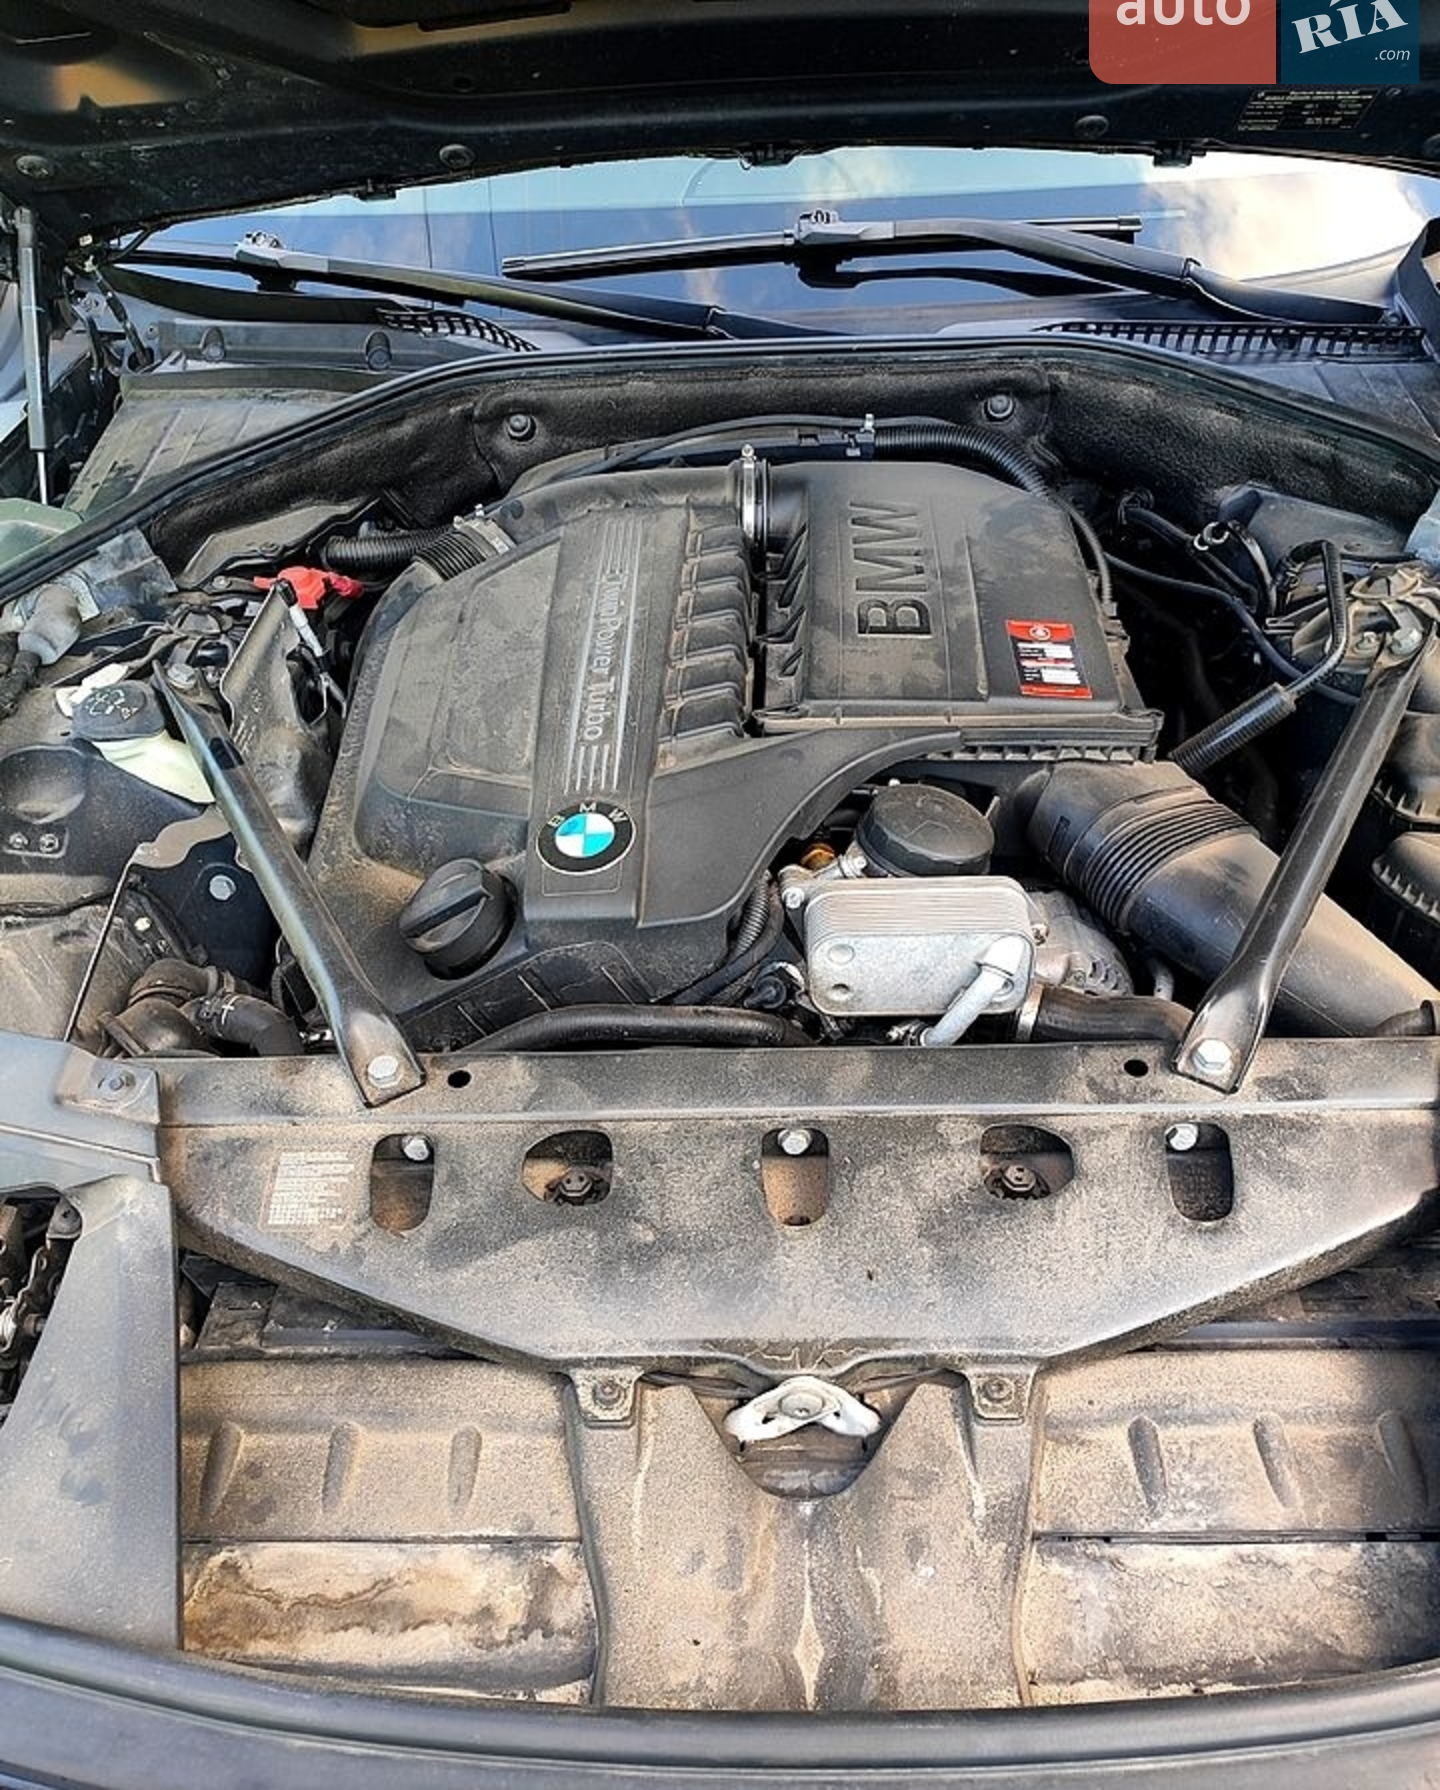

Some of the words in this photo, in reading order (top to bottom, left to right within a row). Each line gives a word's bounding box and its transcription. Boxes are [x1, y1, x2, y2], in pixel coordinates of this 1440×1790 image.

[849, 500, 931, 637] BMW
[584, 676, 615, 740] Turbo
[547, 802, 628, 827] BMW
